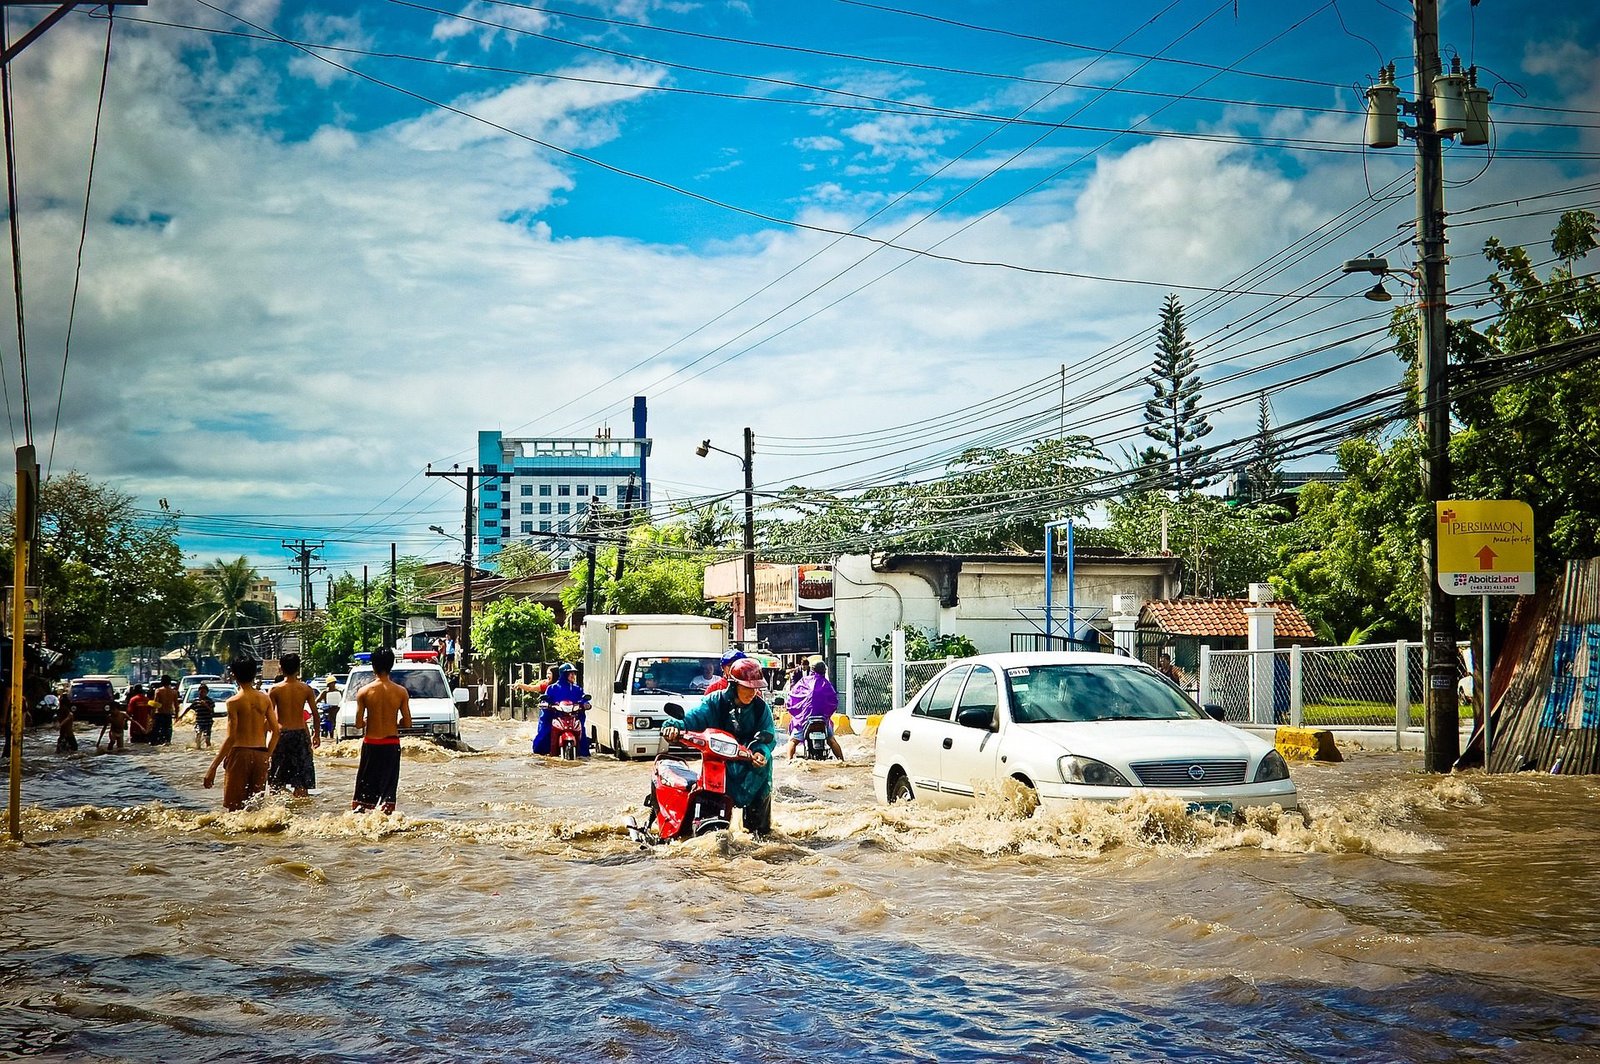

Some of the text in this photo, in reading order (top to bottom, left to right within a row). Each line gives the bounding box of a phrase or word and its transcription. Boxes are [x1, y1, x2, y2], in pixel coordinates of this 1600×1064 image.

[1453, 522, 1523, 535] PERSIMMON
[1511, 535, 1520, 545] for
[1468, 575, 1519, 583] AboitizLand
